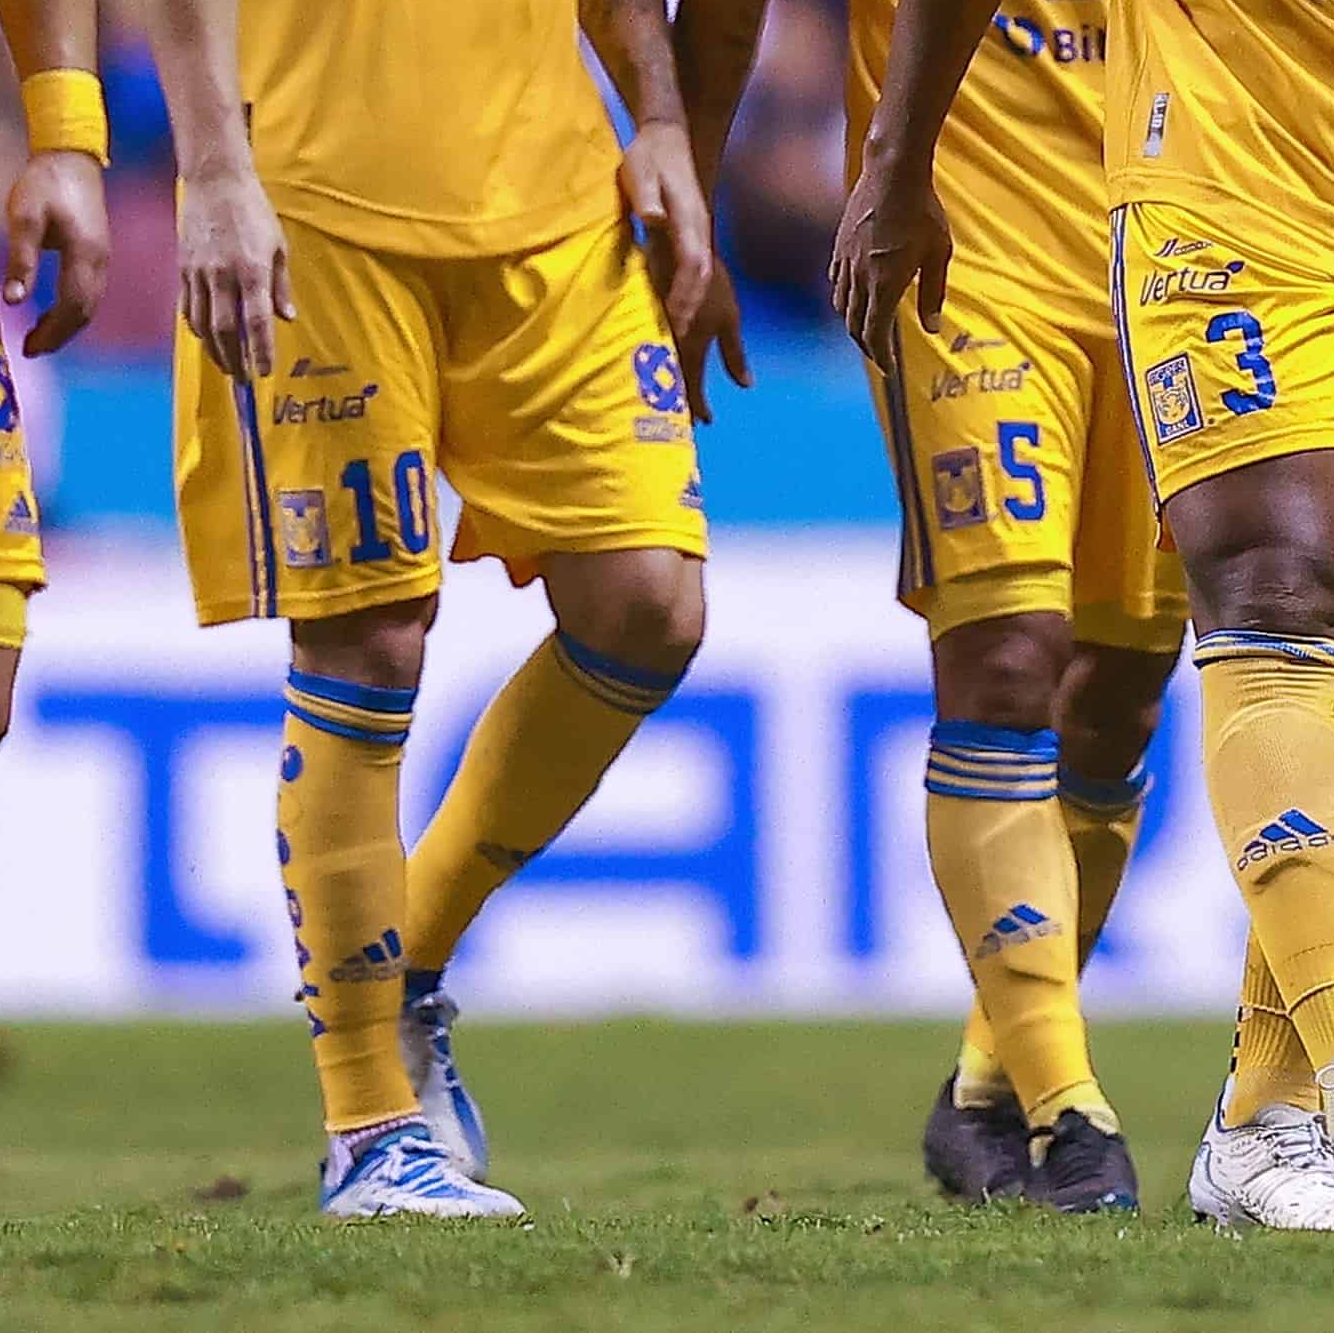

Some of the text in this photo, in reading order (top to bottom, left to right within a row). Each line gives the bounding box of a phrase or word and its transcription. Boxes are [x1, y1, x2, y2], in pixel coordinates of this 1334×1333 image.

[1140, 266, 1231, 307] Vertua
[272, 394, 366, 427] Vertua
[1205, 309, 1277, 416] 3
[340, 449, 431, 565] 10
[995, 419, 1046, 522] 5
